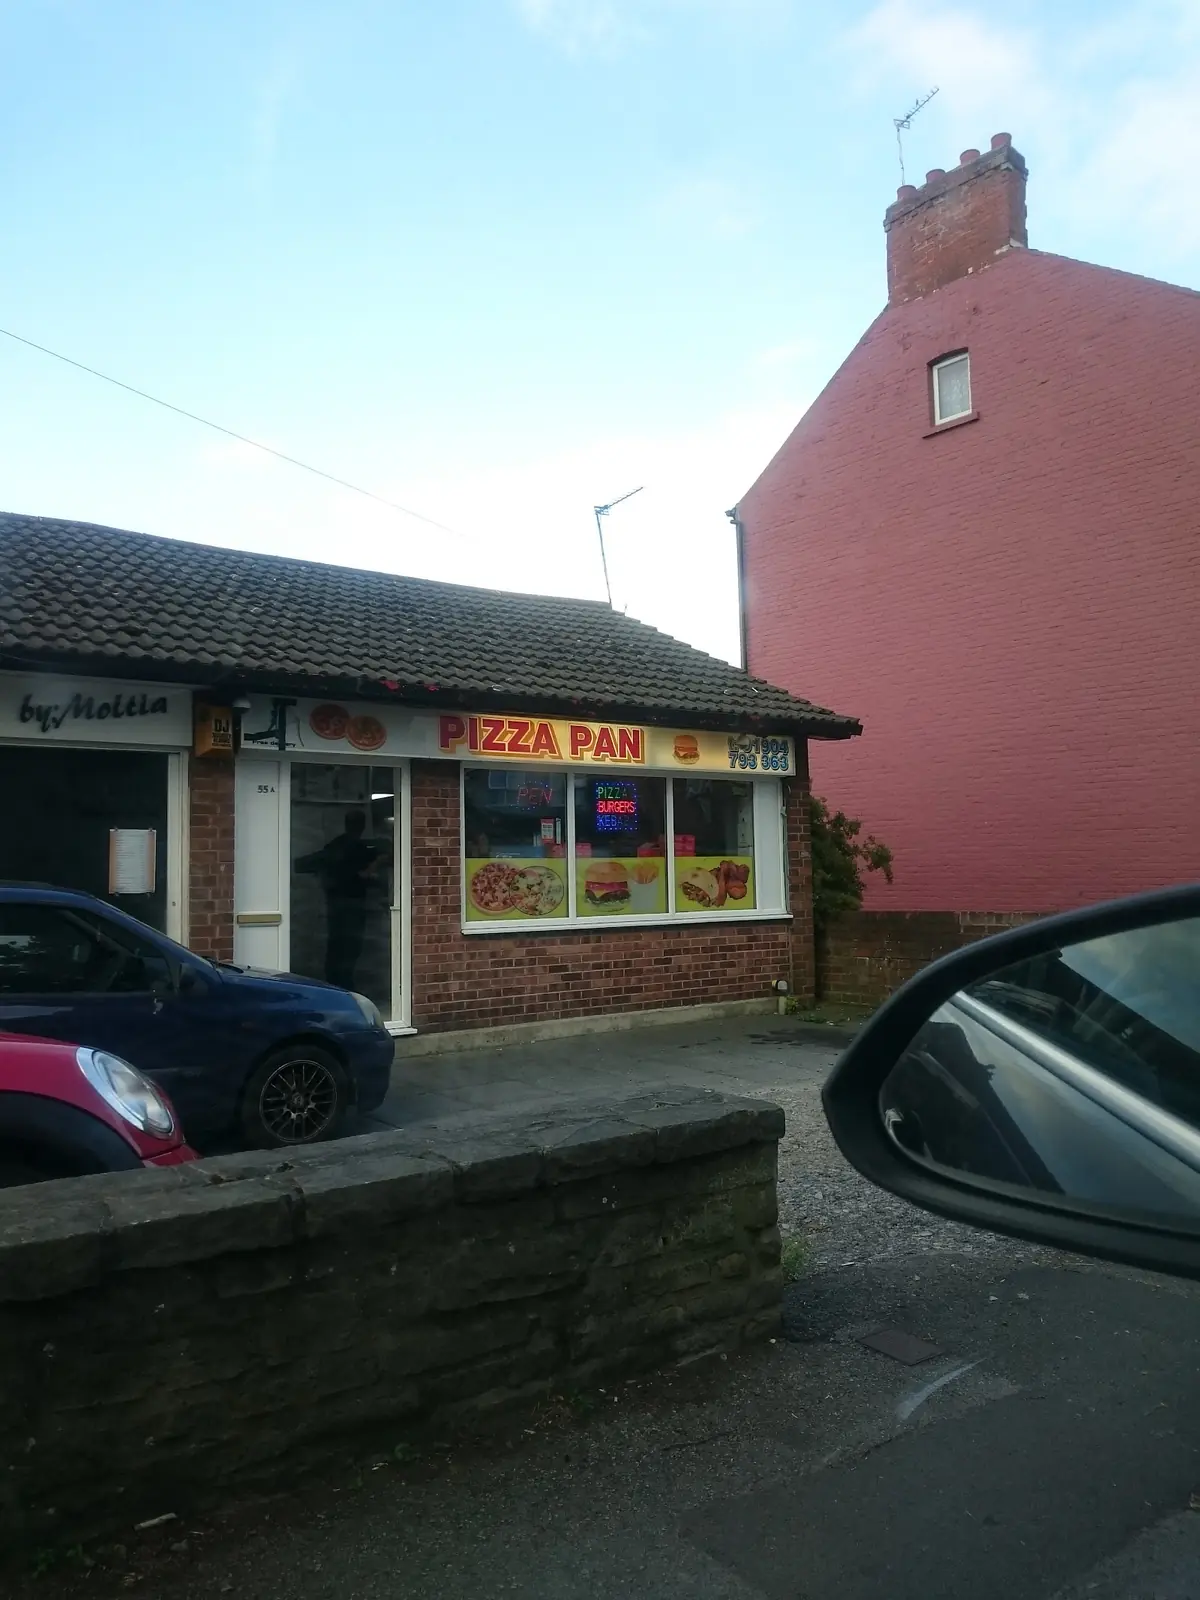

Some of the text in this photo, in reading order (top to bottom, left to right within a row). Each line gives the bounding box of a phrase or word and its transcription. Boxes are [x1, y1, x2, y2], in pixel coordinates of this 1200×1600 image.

[214, 718, 229, 732] DJ
[438, 714, 645, 763] PIZZA PAN
[728, 751, 789, 771] 793 363
[257, 784, 269, 794] 55
[598, 800, 635, 813] BURGERS
